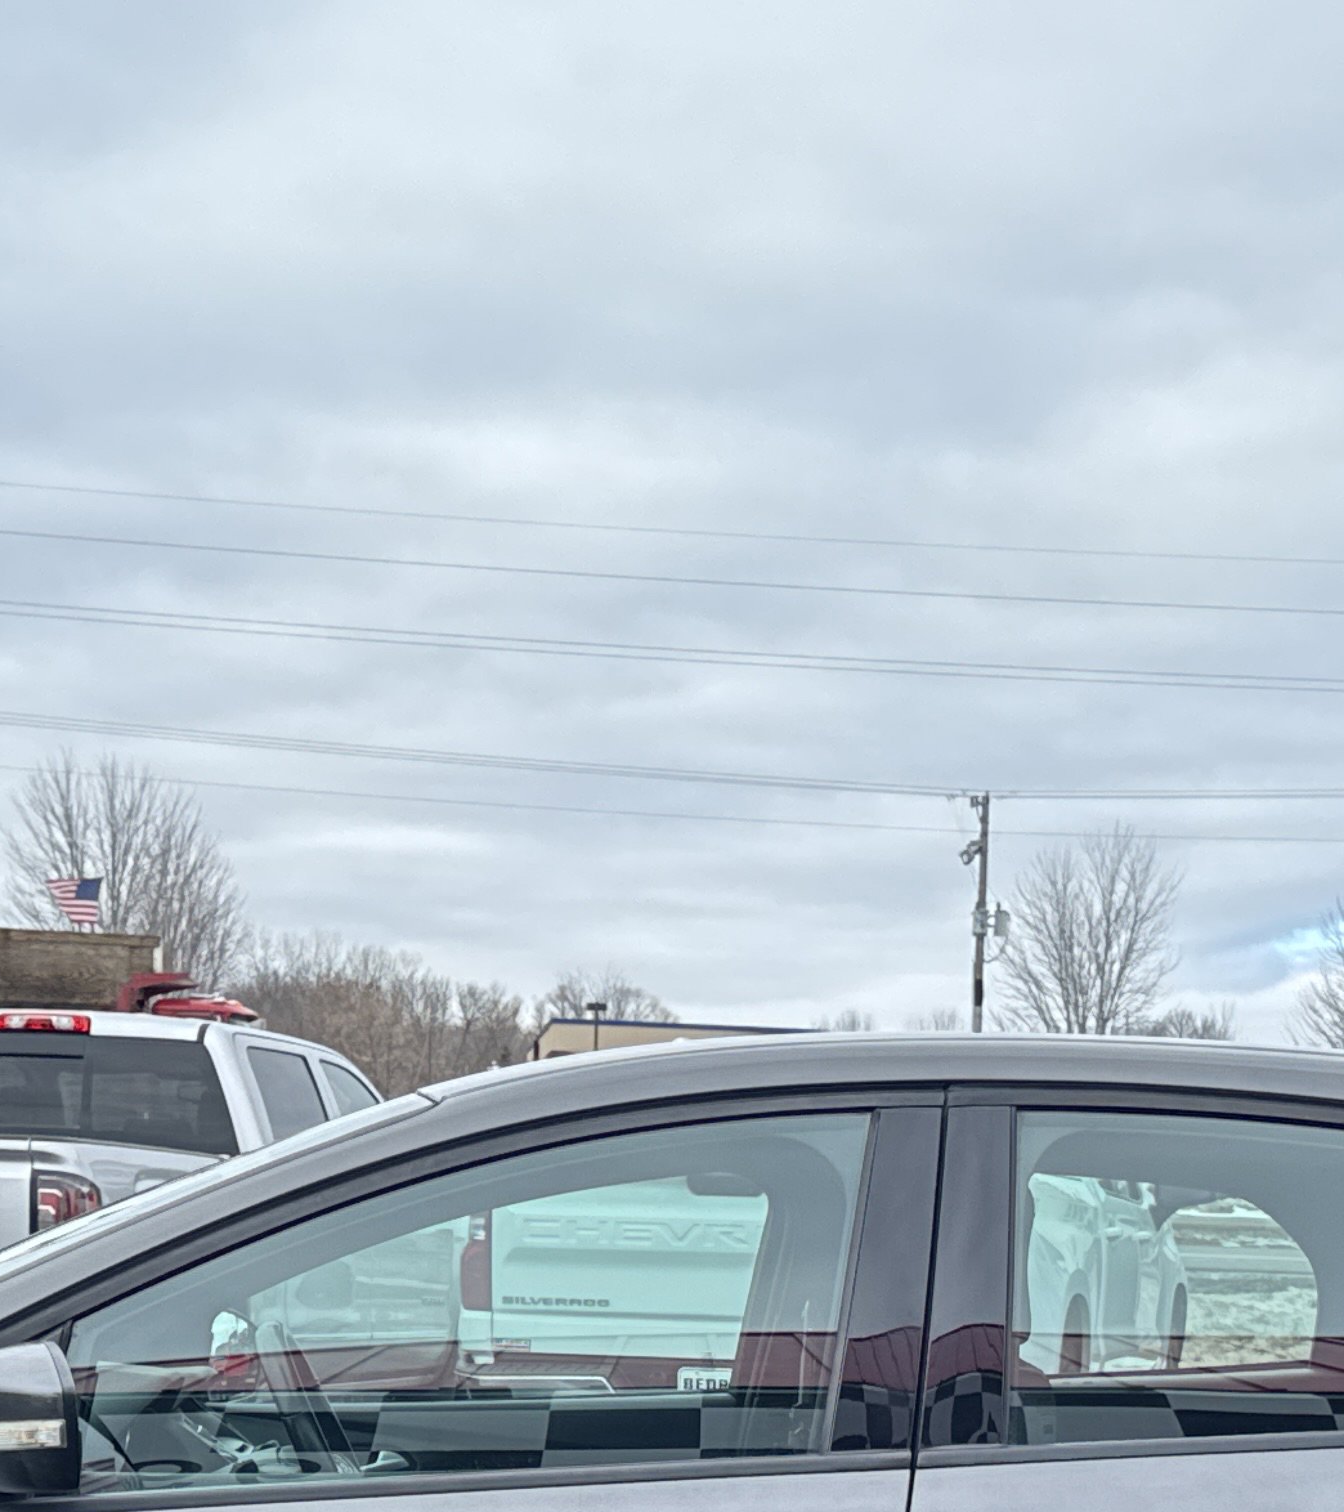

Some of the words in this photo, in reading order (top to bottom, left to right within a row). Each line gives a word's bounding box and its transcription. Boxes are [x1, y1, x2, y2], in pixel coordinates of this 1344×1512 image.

[522, 1217, 756, 1249] CHEVR
[501, 1295, 611, 1308] SILVERADO
[683, 1377, 730, 1391] BEDR
